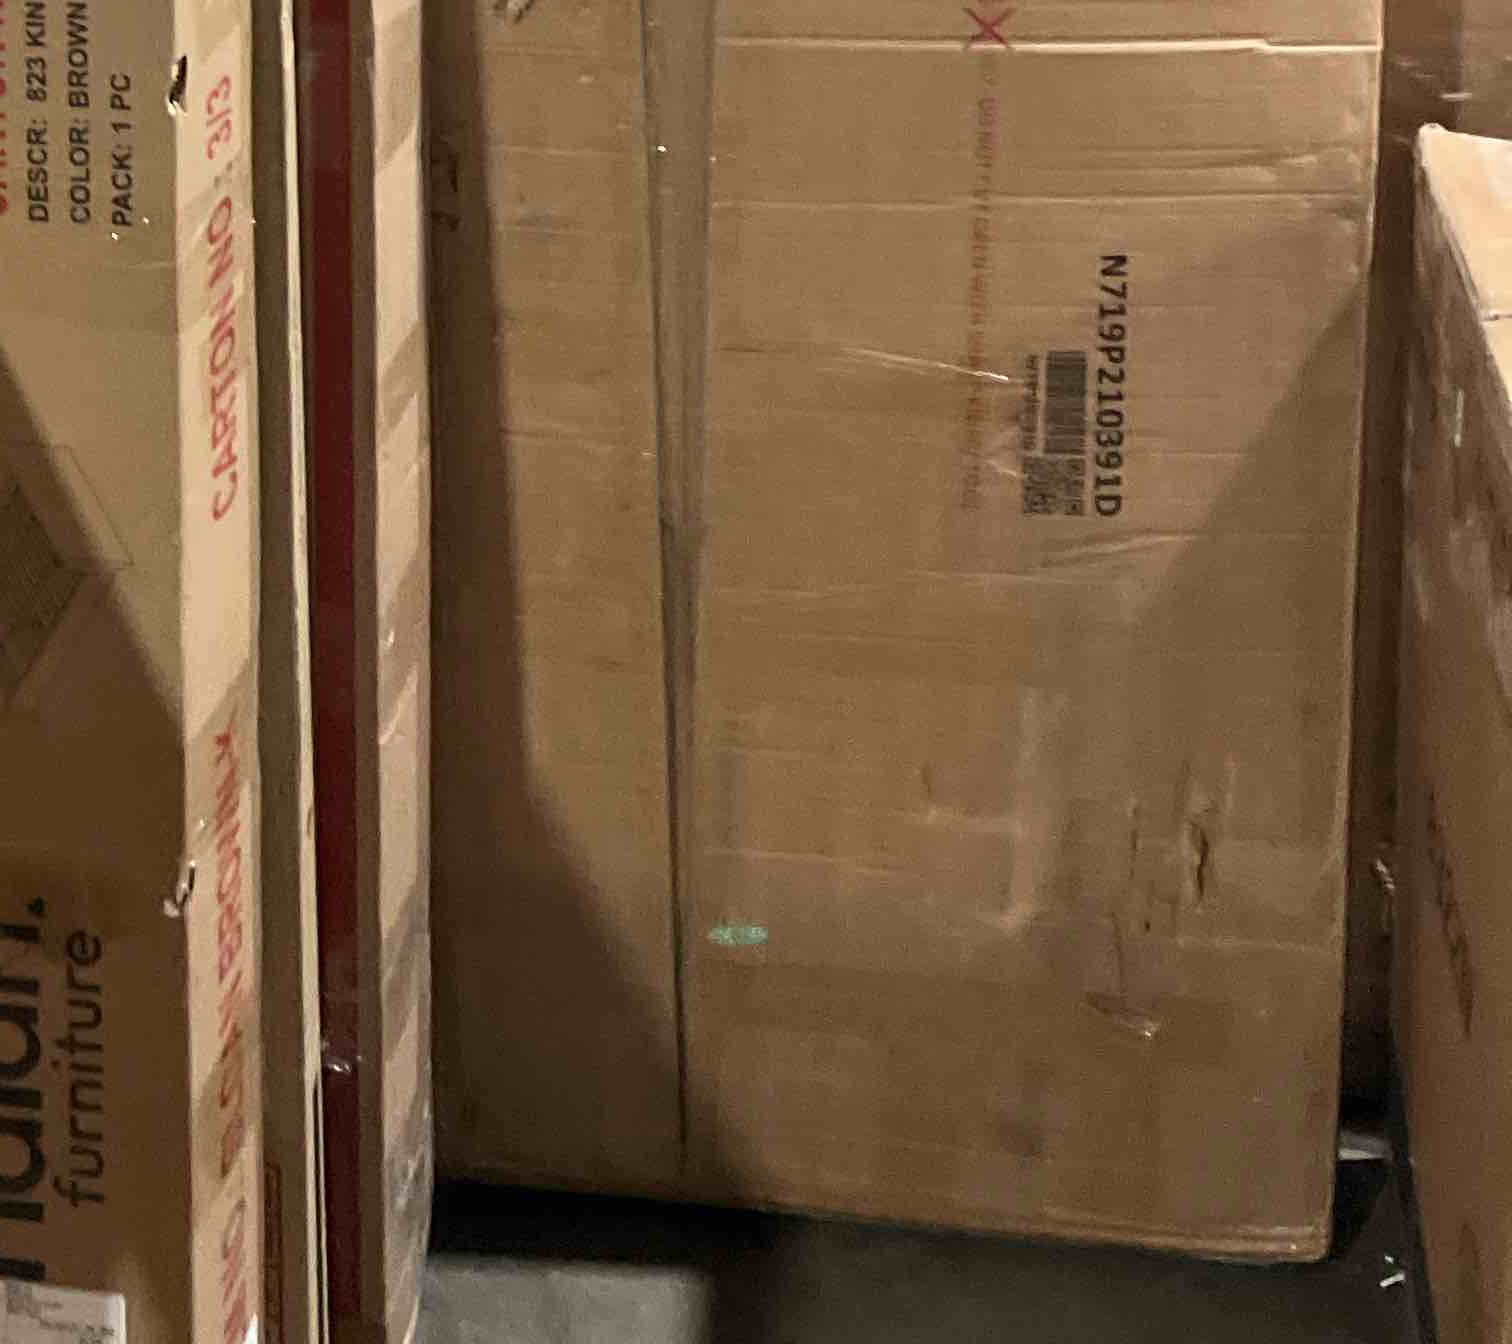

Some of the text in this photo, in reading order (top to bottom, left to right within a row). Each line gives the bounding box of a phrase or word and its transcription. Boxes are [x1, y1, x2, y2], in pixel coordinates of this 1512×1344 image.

[25, 56, 48, 107] 823
[26, 116, 50, 223] DESCR:
[66, 0, 92, 224] COLOR: BROWN
[107, 71, 133, 228] PACK: 1 PC
[208, 287, 239, 522] CARTON
[1095, 253, 1129, 518] N719P210391D
[52, 928, 105, 1209] furniture
